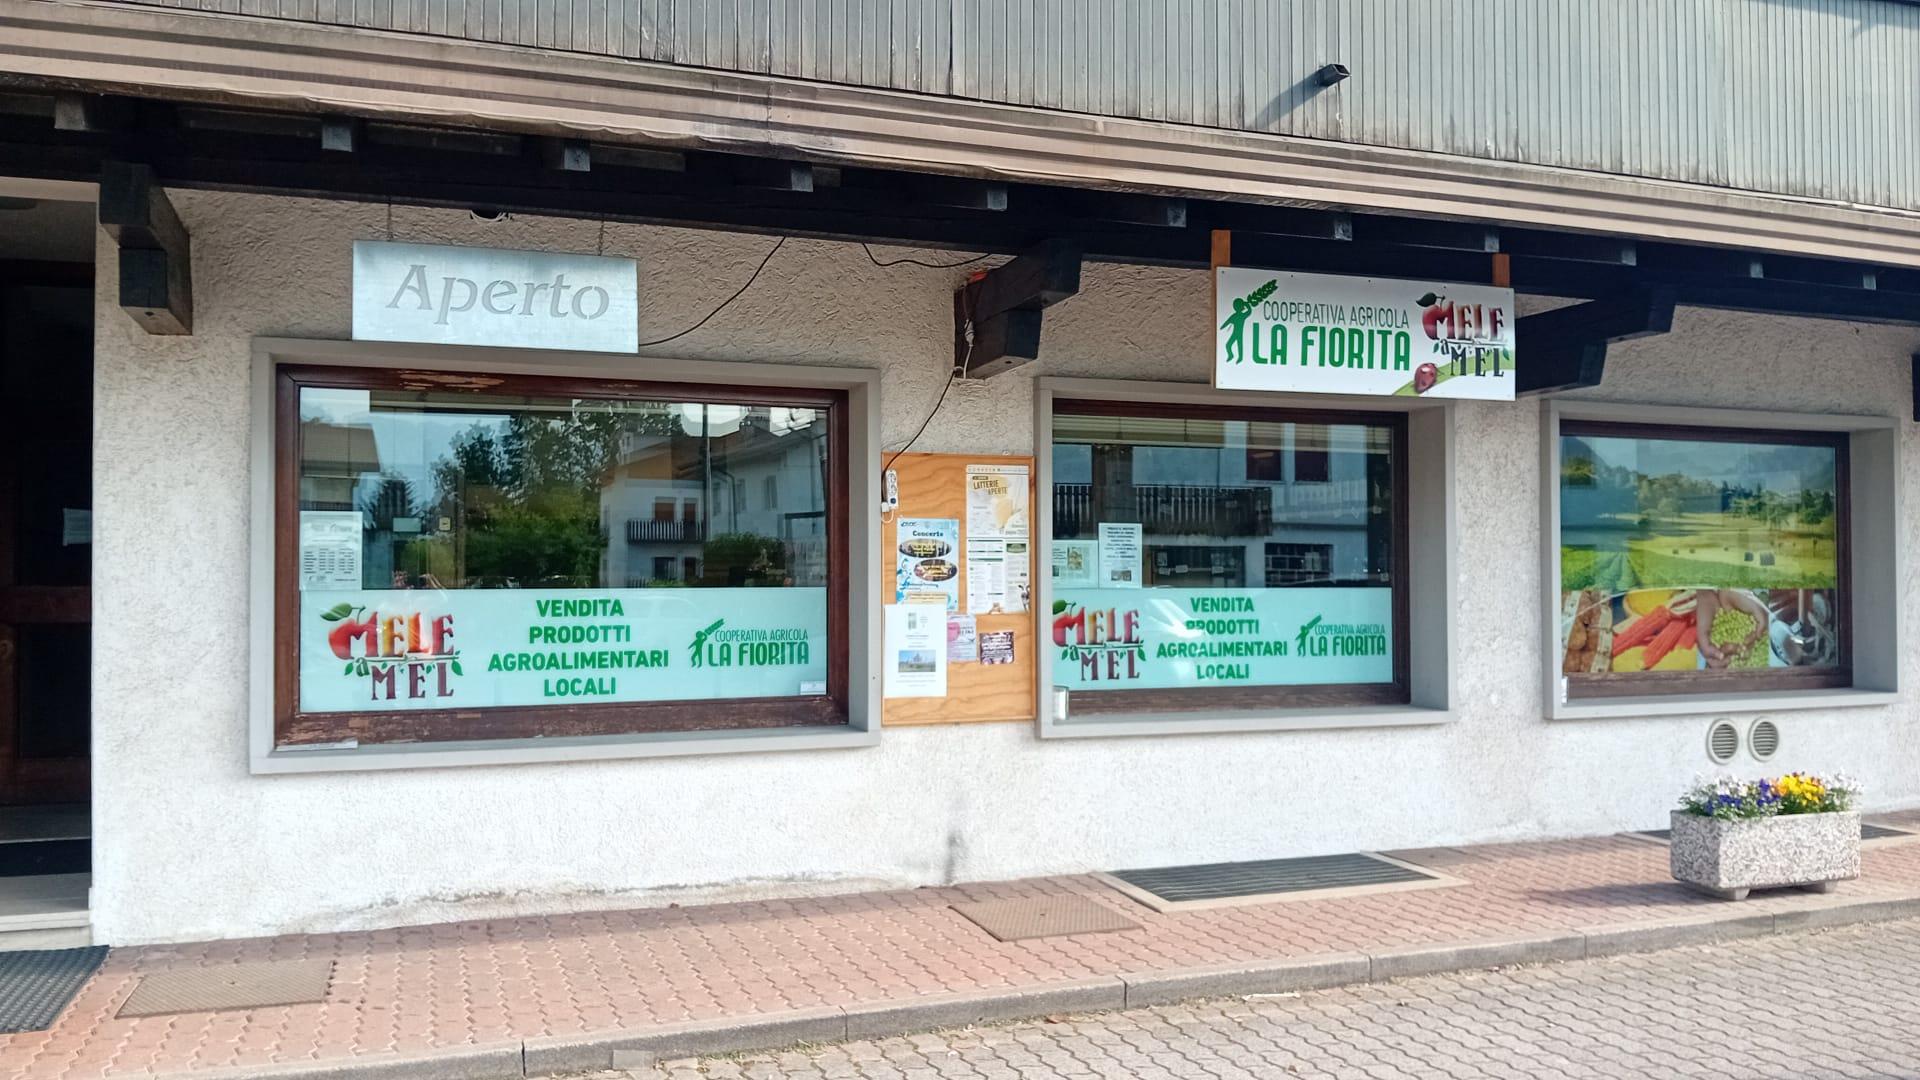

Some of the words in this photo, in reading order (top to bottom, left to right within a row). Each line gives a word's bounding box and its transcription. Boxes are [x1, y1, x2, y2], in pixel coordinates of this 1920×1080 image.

[385, 264, 610, 325] Aperto
[1263, 300, 1346, 325] COOPERATIVA
[1349, 305, 1410, 329] AGRICOLA
[1422, 300, 1504, 342] MELE
[1252, 322, 1288, 365] LA
[1300, 325, 1411, 371] FIORITA
[1450, 346, 1504, 377] MEL
[536, 599, 624, 617] VENDITA
[1190, 597, 1255, 613] VENDITA
[328, 611, 454, 660] MELE
[529, 625, 631, 644] PRODOTTI
[715, 629, 768, 642] COOPERATIVA
[770, 628, 808, 641] AGRICOLA
[1053, 606, 1140, 647] MELE
[1185, 618, 1259, 635] PRODOTTI
[1315, 624, 1354, 635] COOPERATIVA
[1356, 623, 1385, 635] AGRICOLA
[708, 642, 732, 667] LA
[738, 641, 809, 666] FIORITA
[1156, 640, 1288, 658] AGROALIMENTARI
[1310, 635, 1328, 657] LA
[1332, 635, 1386, 656] FIORITA
[487, 649, 669, 672] AGROALIMENTARI
[1080, 649, 1140, 681] MEL
[1196, 663, 1250, 680] LOCALI
[371, 662, 454, 701] MEL
[544, 677, 616, 697] LOCALI
